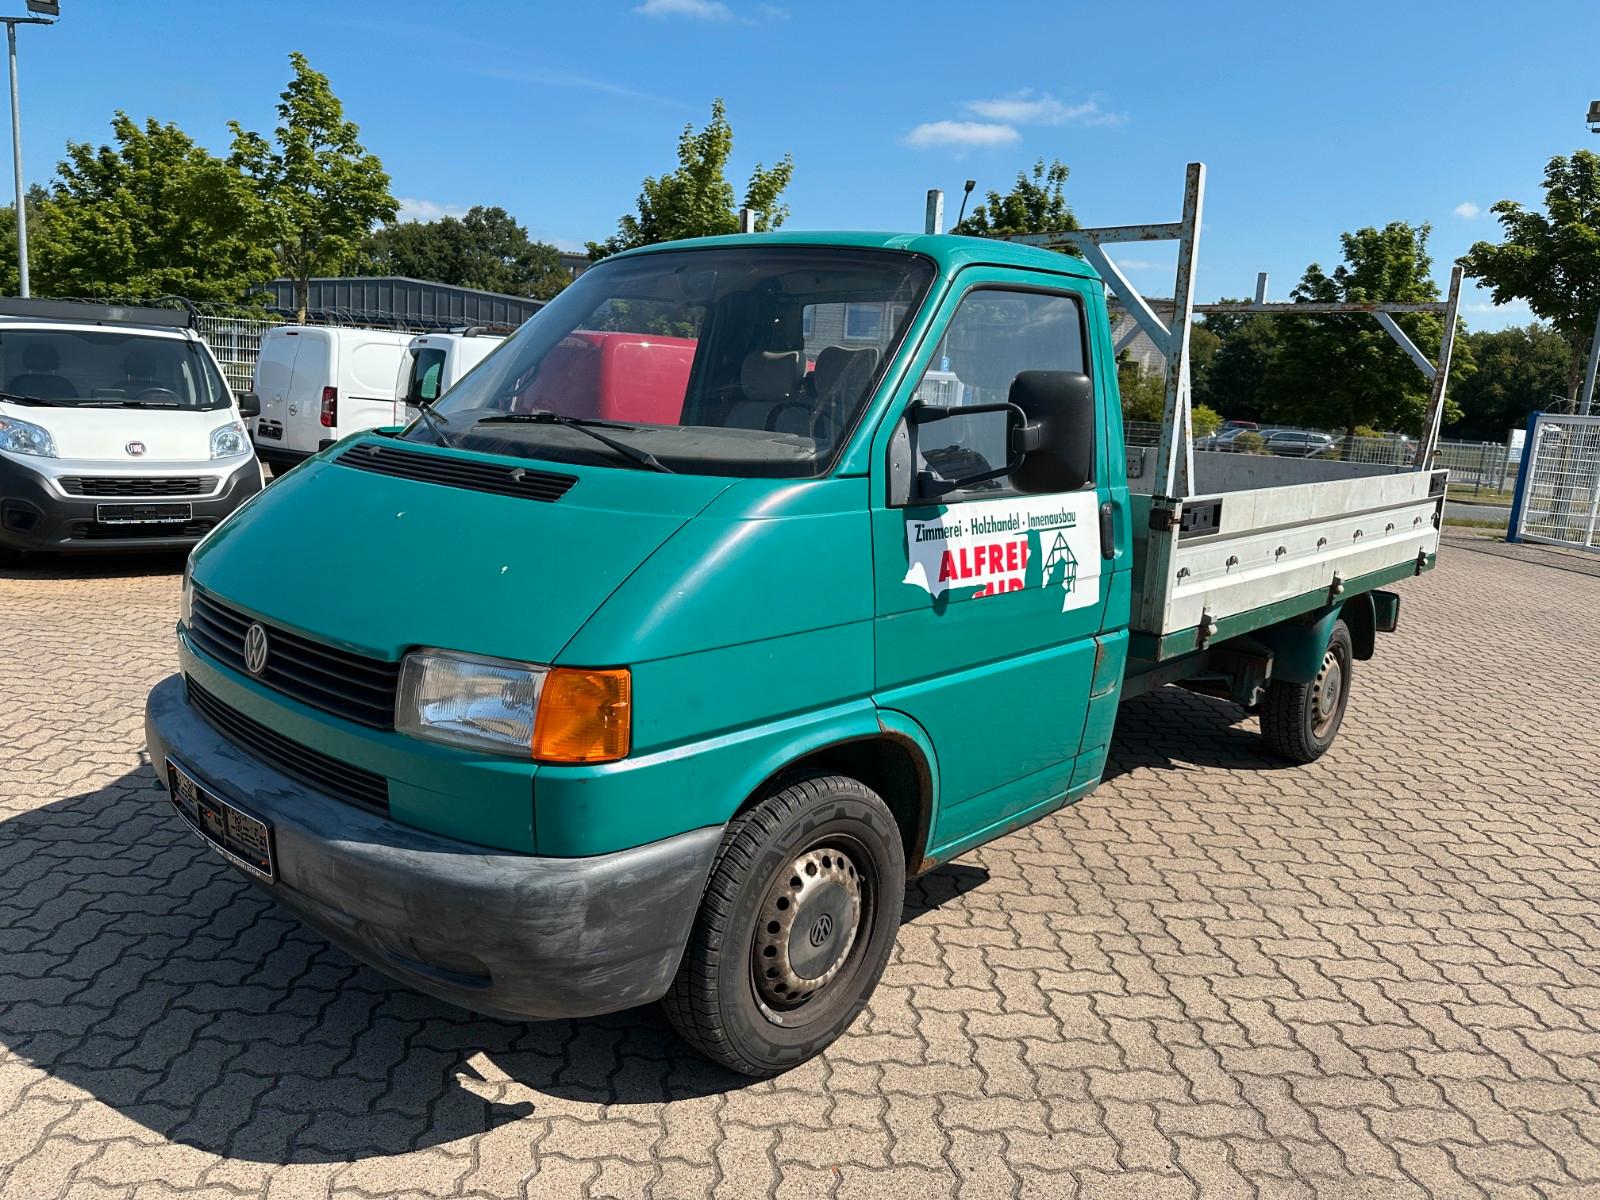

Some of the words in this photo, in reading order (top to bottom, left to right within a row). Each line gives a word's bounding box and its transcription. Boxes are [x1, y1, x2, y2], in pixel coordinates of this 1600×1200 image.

[914, 520, 962, 543] Zimmerei
[970, 512, 1020, 536] Holzhandel
[1027, 507, 1076, 528] Innenausbau
[245, 624, 267, 673] VW
[810, 914, 832, 947] VW
